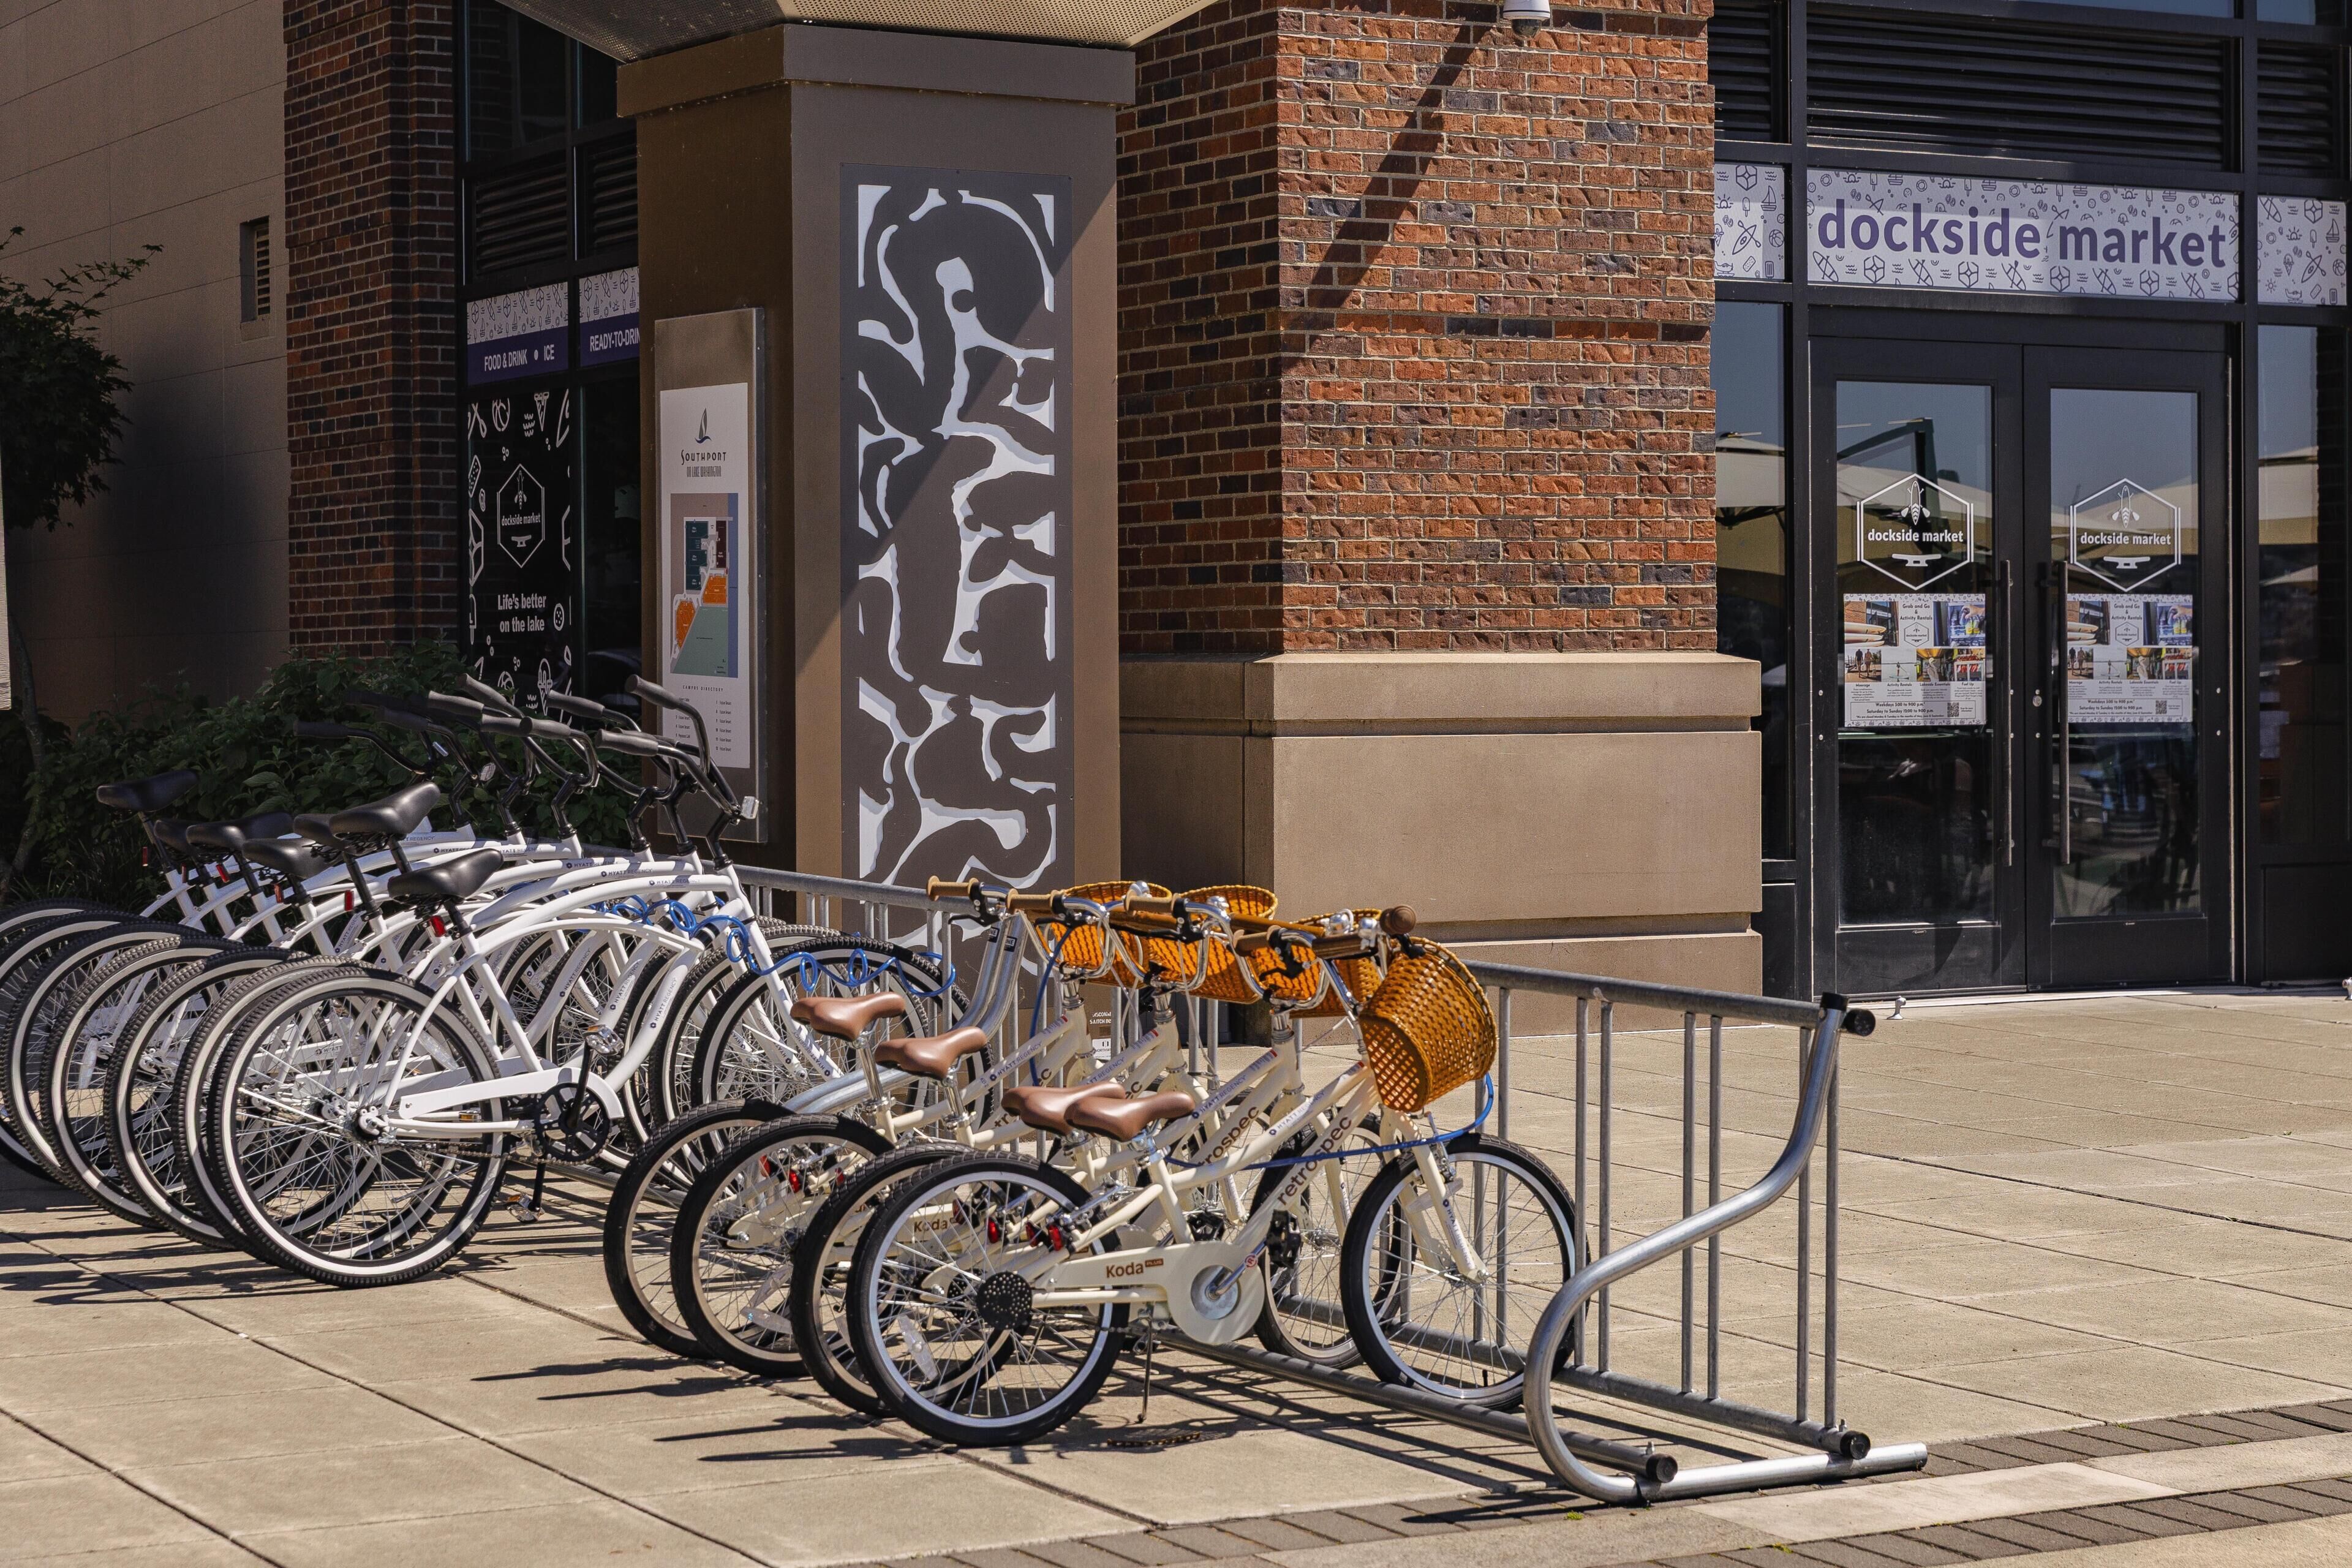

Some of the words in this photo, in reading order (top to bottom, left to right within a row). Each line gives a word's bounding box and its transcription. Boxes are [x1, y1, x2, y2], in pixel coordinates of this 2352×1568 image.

[1818, 199, 2041, 258] dockside
[2059, 217, 2226, 268] market
[484, 355, 501, 371] FOOD
[502, 353, 507, 368] &
[508, 349, 527, 368] DRINK
[544, 344, 554, 360] ICE
[681, 450, 726, 466] SOUTHPORT
[502, 514, 522, 526] dockside
[524, 512, 541, 524] market
[1868, 529, 1919, 541] dockside
[1923, 529, 1963, 542] market
[2081, 532, 2129, 544] dockside
[2133, 533, 2171, 545] market
[498, 594, 519, 610] Life's
[521, 593, 546, 609] better
[500, 620, 510, 632] on
[511, 616, 525, 632] the
[527, 616, 545, 631] lake
[339, 932, 350, 947] HYATT
[564, 973, 577, 990] HYATT
[614, 986, 626, 1003] HYATT
[625, 962, 640, 987] REGENCY
[655, 1004, 666, 1021] HYATT
[663, 978, 677, 1003] REGENCY
[810, 1054, 825, 1070] HYATT
[998, 1060, 1017, 1076] HYATT
[1016, 1043, 1041, 1063] REGENCY
[1098, 1057, 1125, 1079] REGENCY
[1200, 1096, 1220, 1113] HYATT
[1219, 1074, 1246, 1098] REGENCY
[1277, 1112, 1298, 1129] HYATT
[914, 1219, 948, 1232] Koda
[1106, 1262, 1144, 1278] Koda
